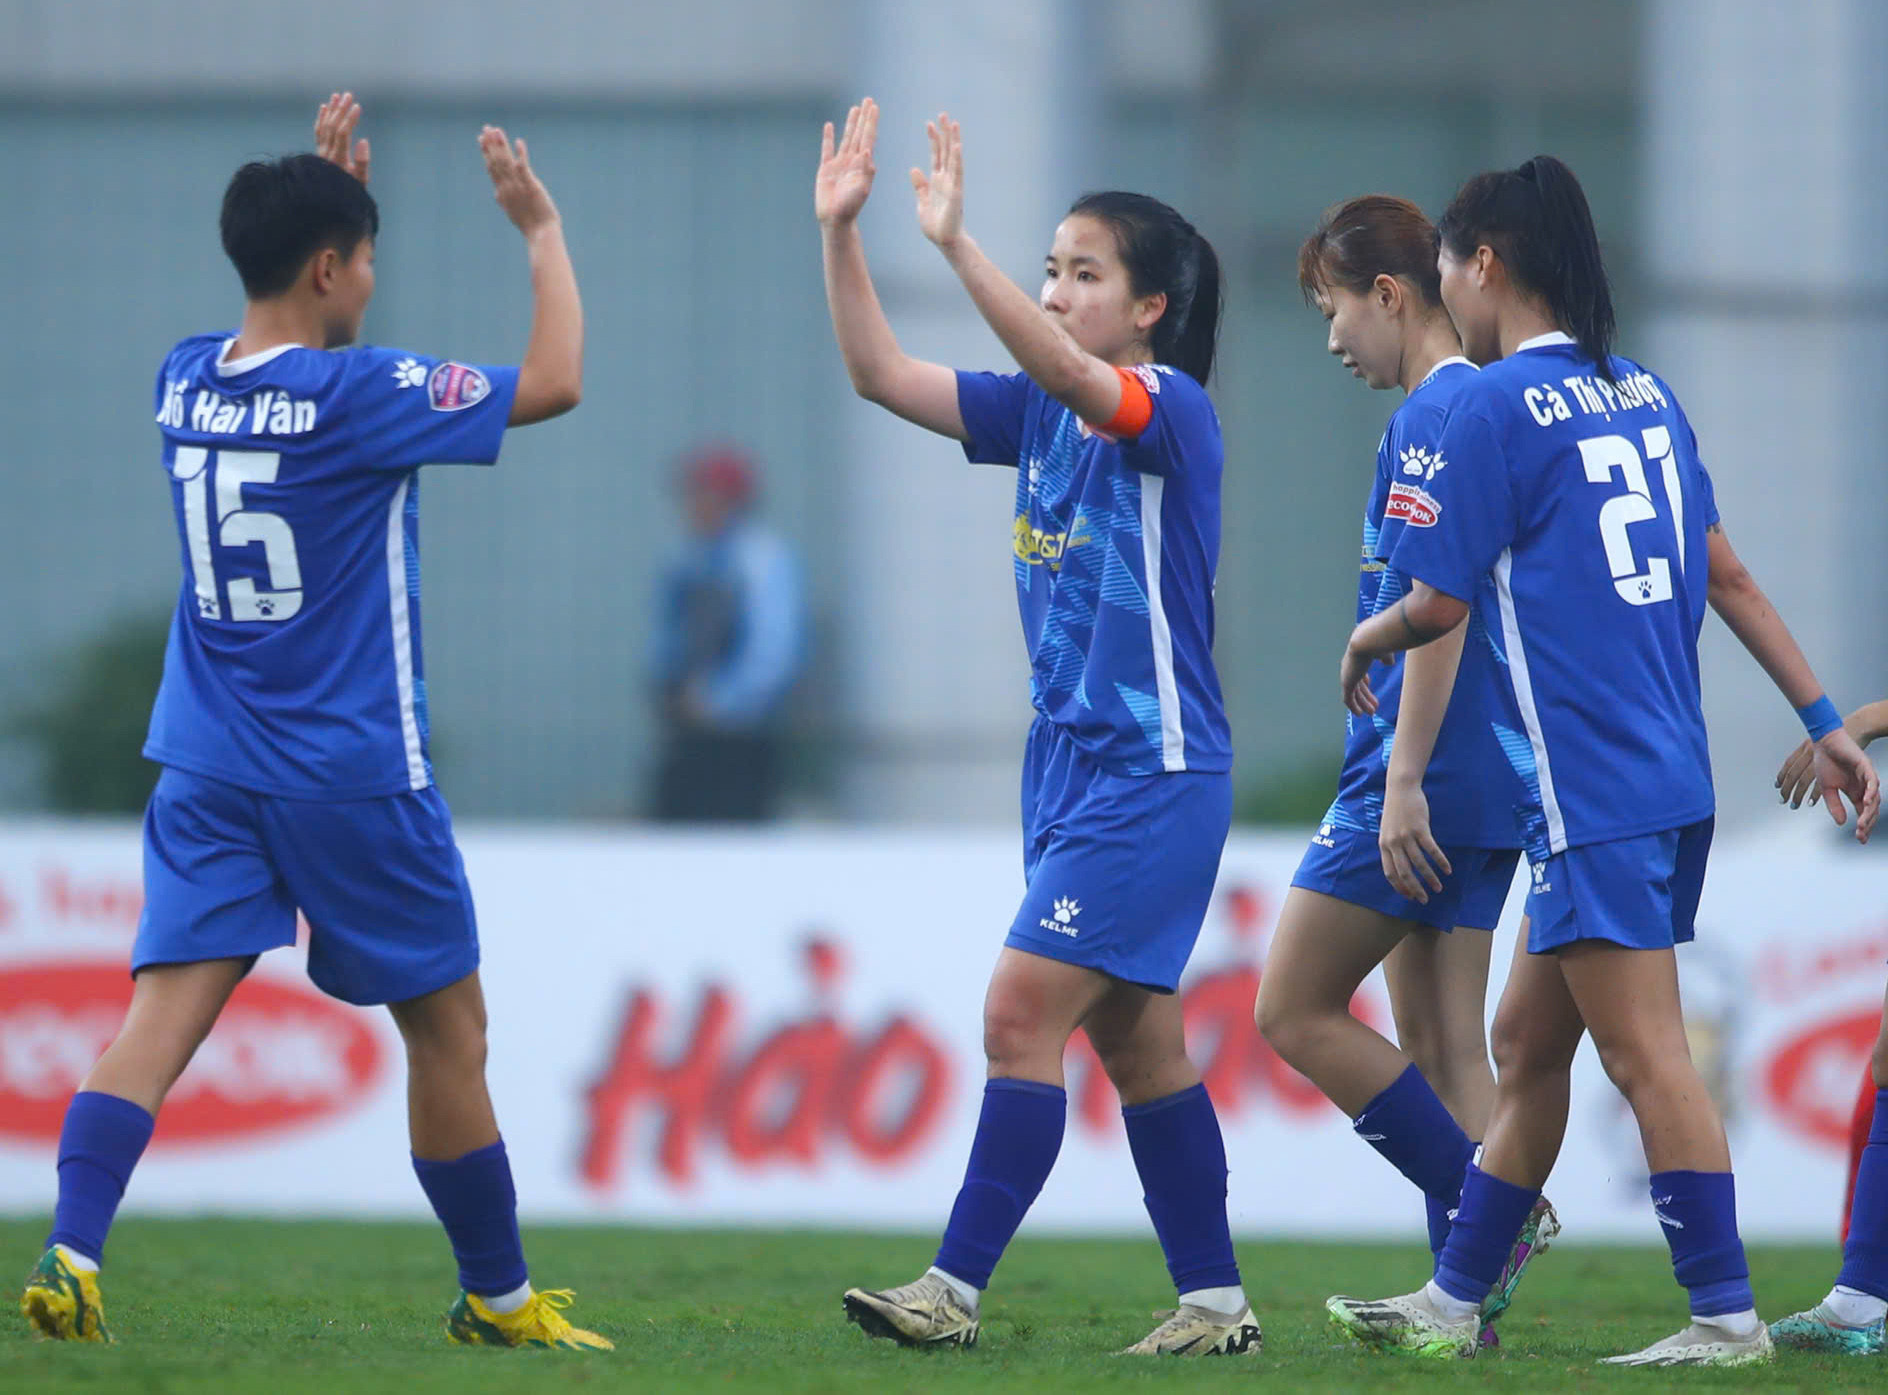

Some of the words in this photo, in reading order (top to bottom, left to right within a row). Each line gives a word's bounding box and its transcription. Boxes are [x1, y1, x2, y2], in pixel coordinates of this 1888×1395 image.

[251, 390, 317, 435] Vân
[1523, 383, 1573, 427] Cà
[1562, 375, 1612, 423] Thị
[172, 445, 304, 623] 15
[1576, 425, 1685, 606] 21
[1039, 918, 1079, 938] KELME
